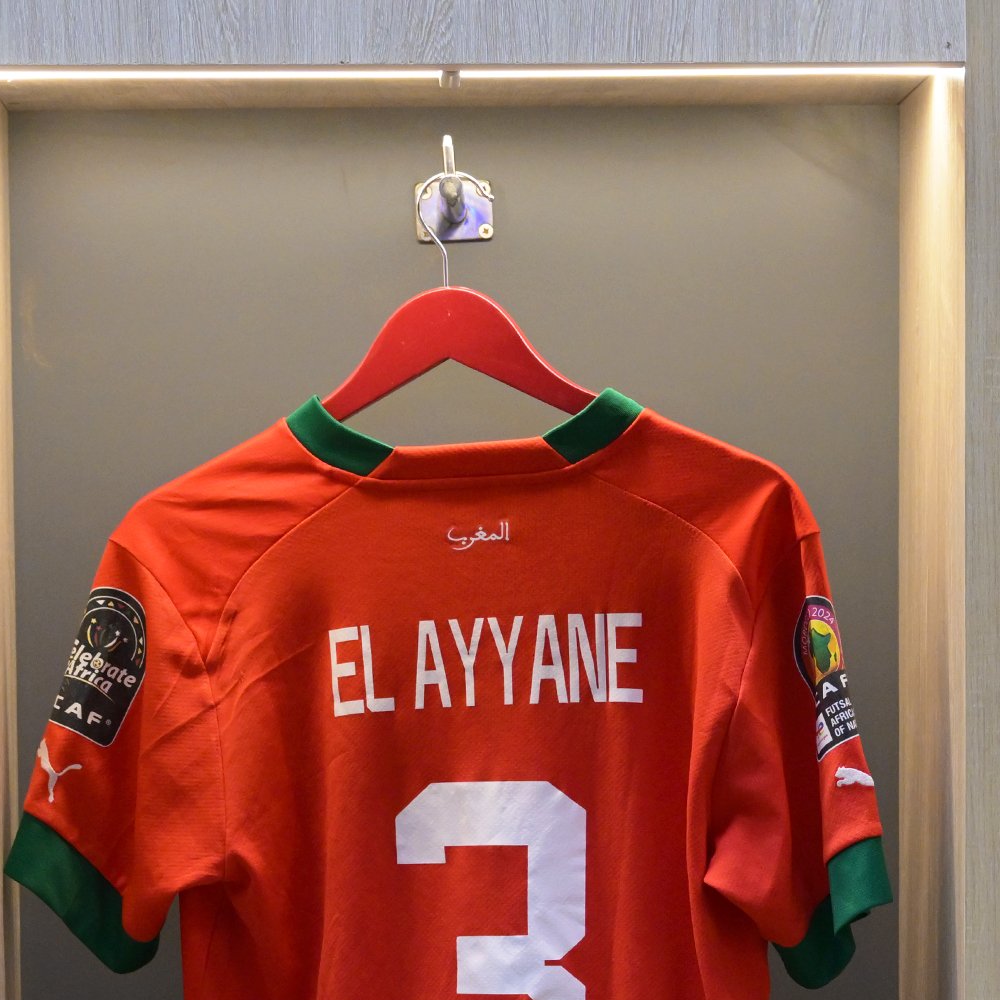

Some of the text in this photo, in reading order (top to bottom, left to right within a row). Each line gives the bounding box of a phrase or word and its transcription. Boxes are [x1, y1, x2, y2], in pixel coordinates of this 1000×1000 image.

[447, 521, 509, 551] المغرب
[328, 612, 643, 717] EL AYYANE
[815, 673, 848, 707] AF
[834, 724, 845, 737] OF
